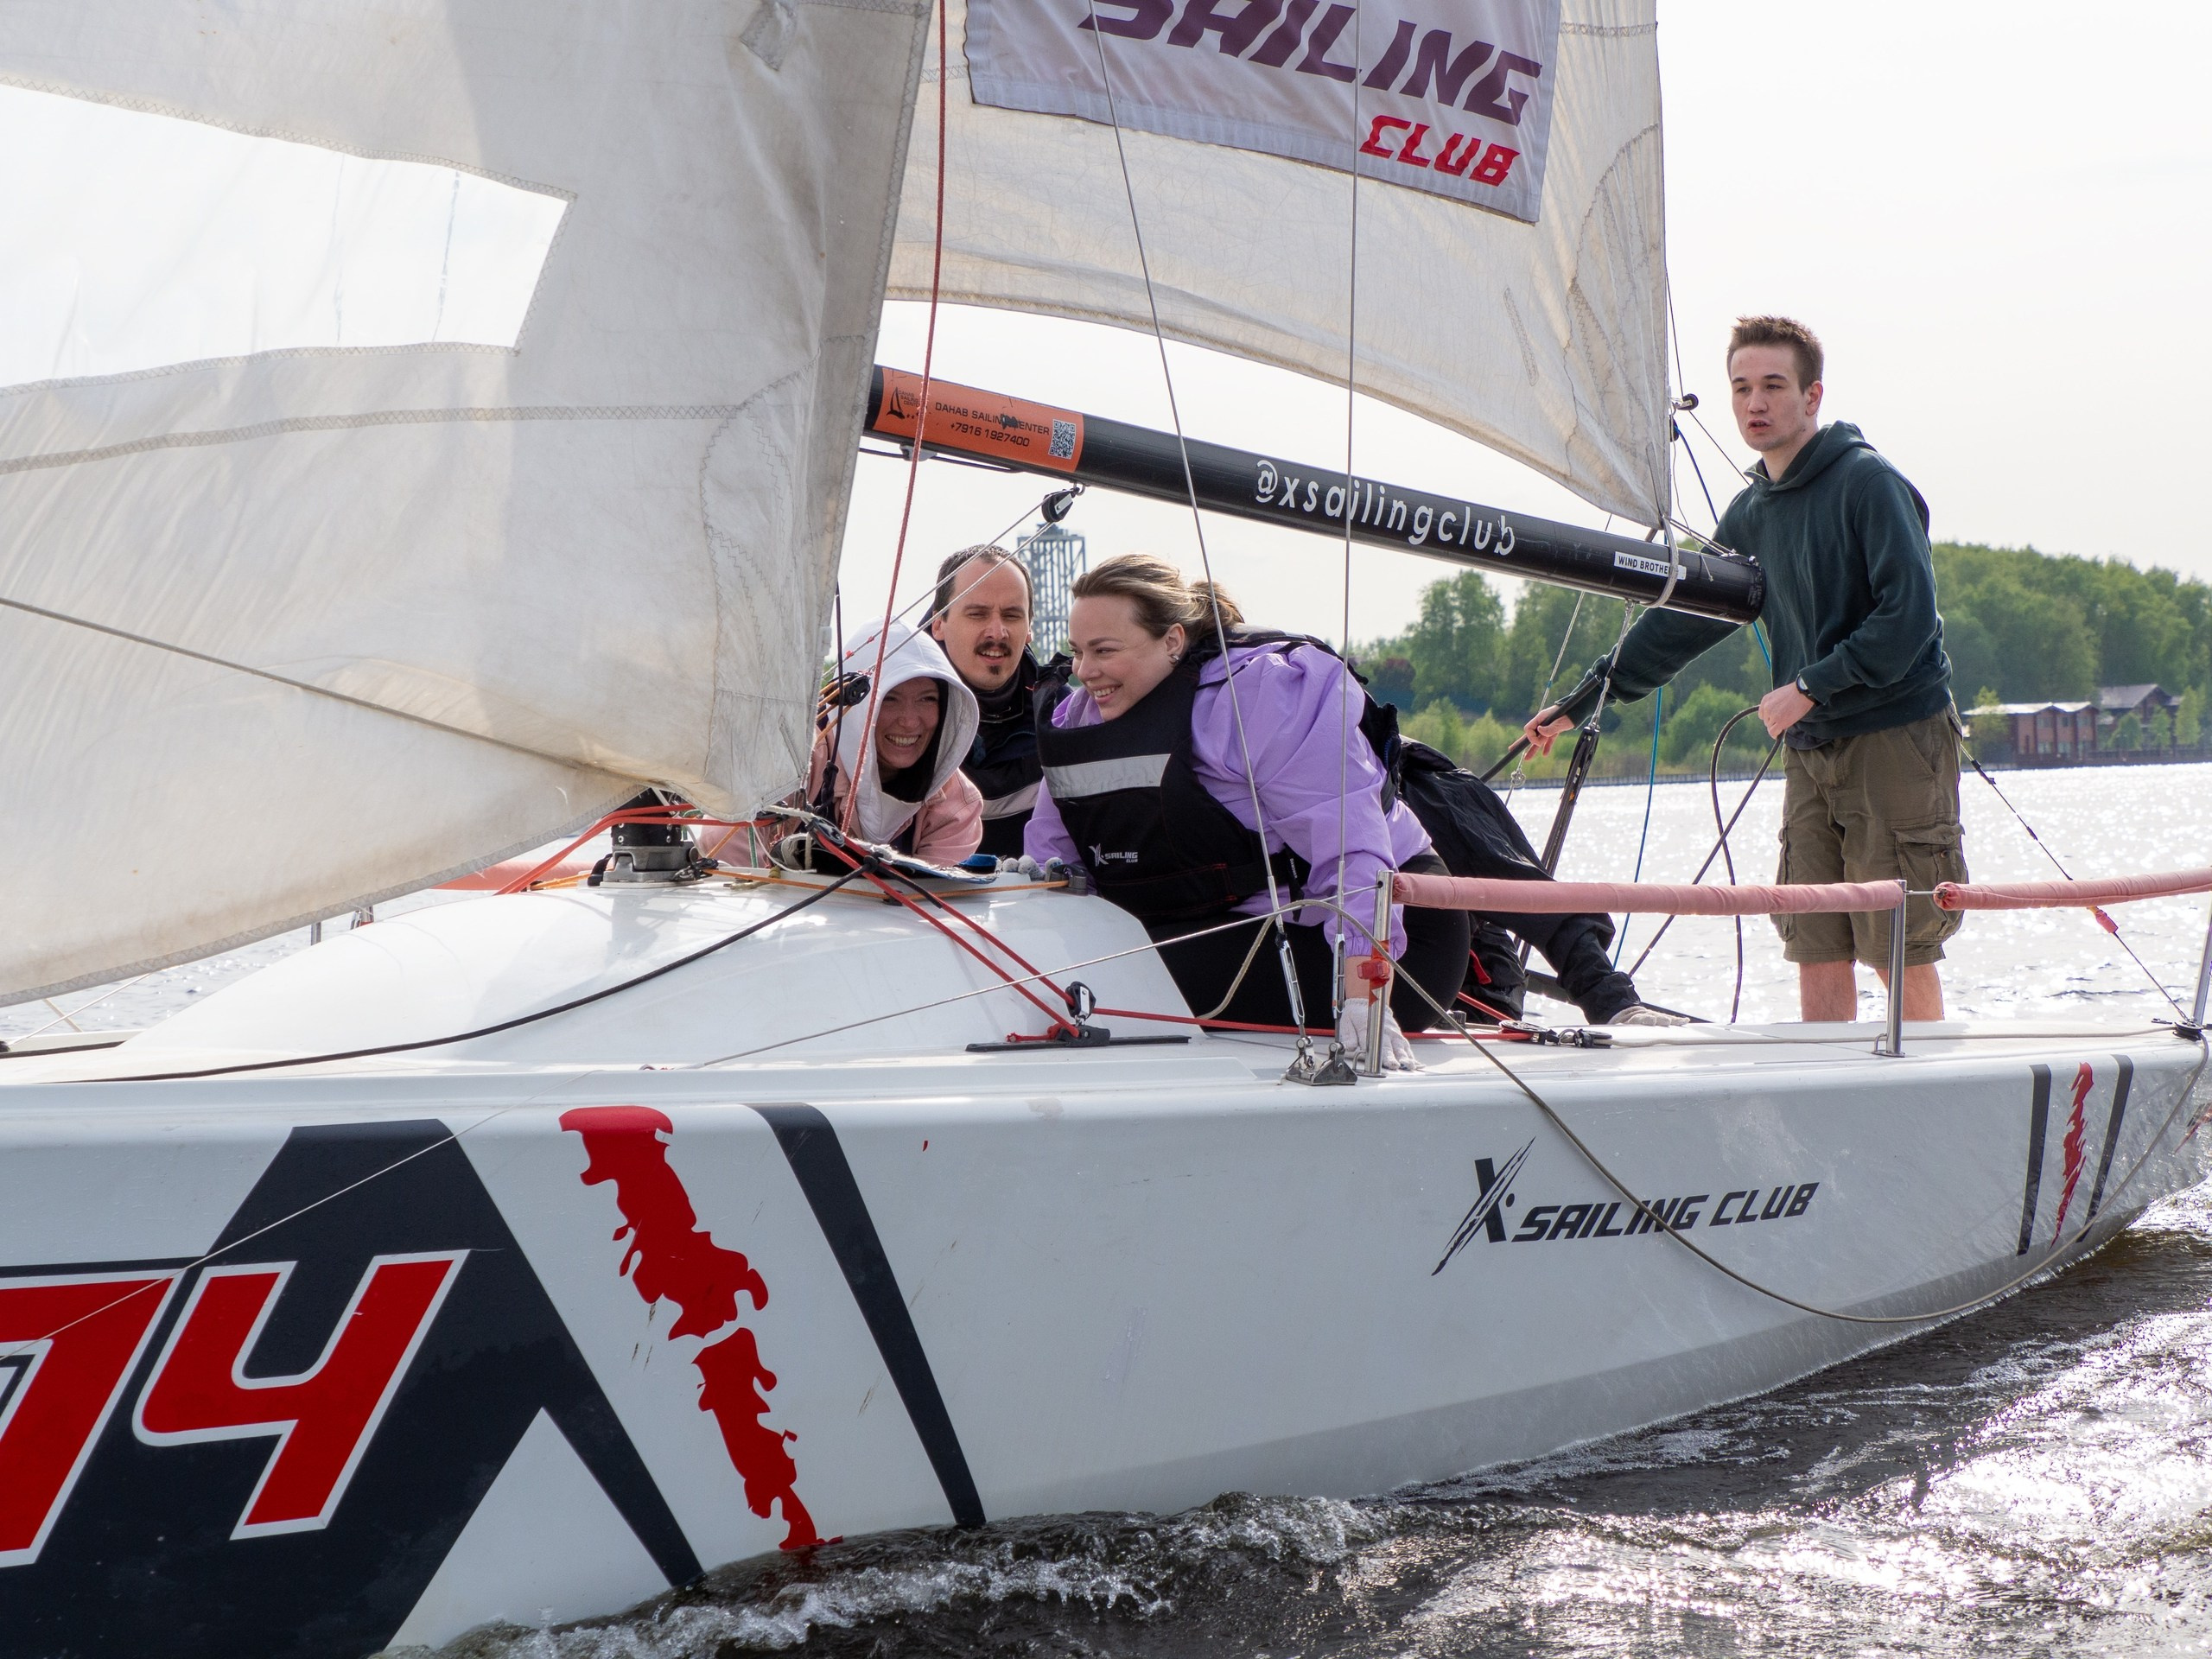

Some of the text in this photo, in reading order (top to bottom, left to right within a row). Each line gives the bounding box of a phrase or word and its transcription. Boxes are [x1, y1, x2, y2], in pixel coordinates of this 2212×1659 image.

[1077, 0, 1543, 127] SAILING
[1358, 114, 1521, 188] CLUB
[935, 402, 1050, 435] DAHAB SAILIN ENTER
[950, 423, 1030, 448] +7916 1927400
[1255, 459, 1516, 556] @xsailingclub
[1618, 556, 1671, 575] WIND BROTHE
[1104, 851, 1139, 860] SAILING
[1510, 1194, 1710, 1243] SAILING
[1708, 1182, 1820, 1227] CLUB
